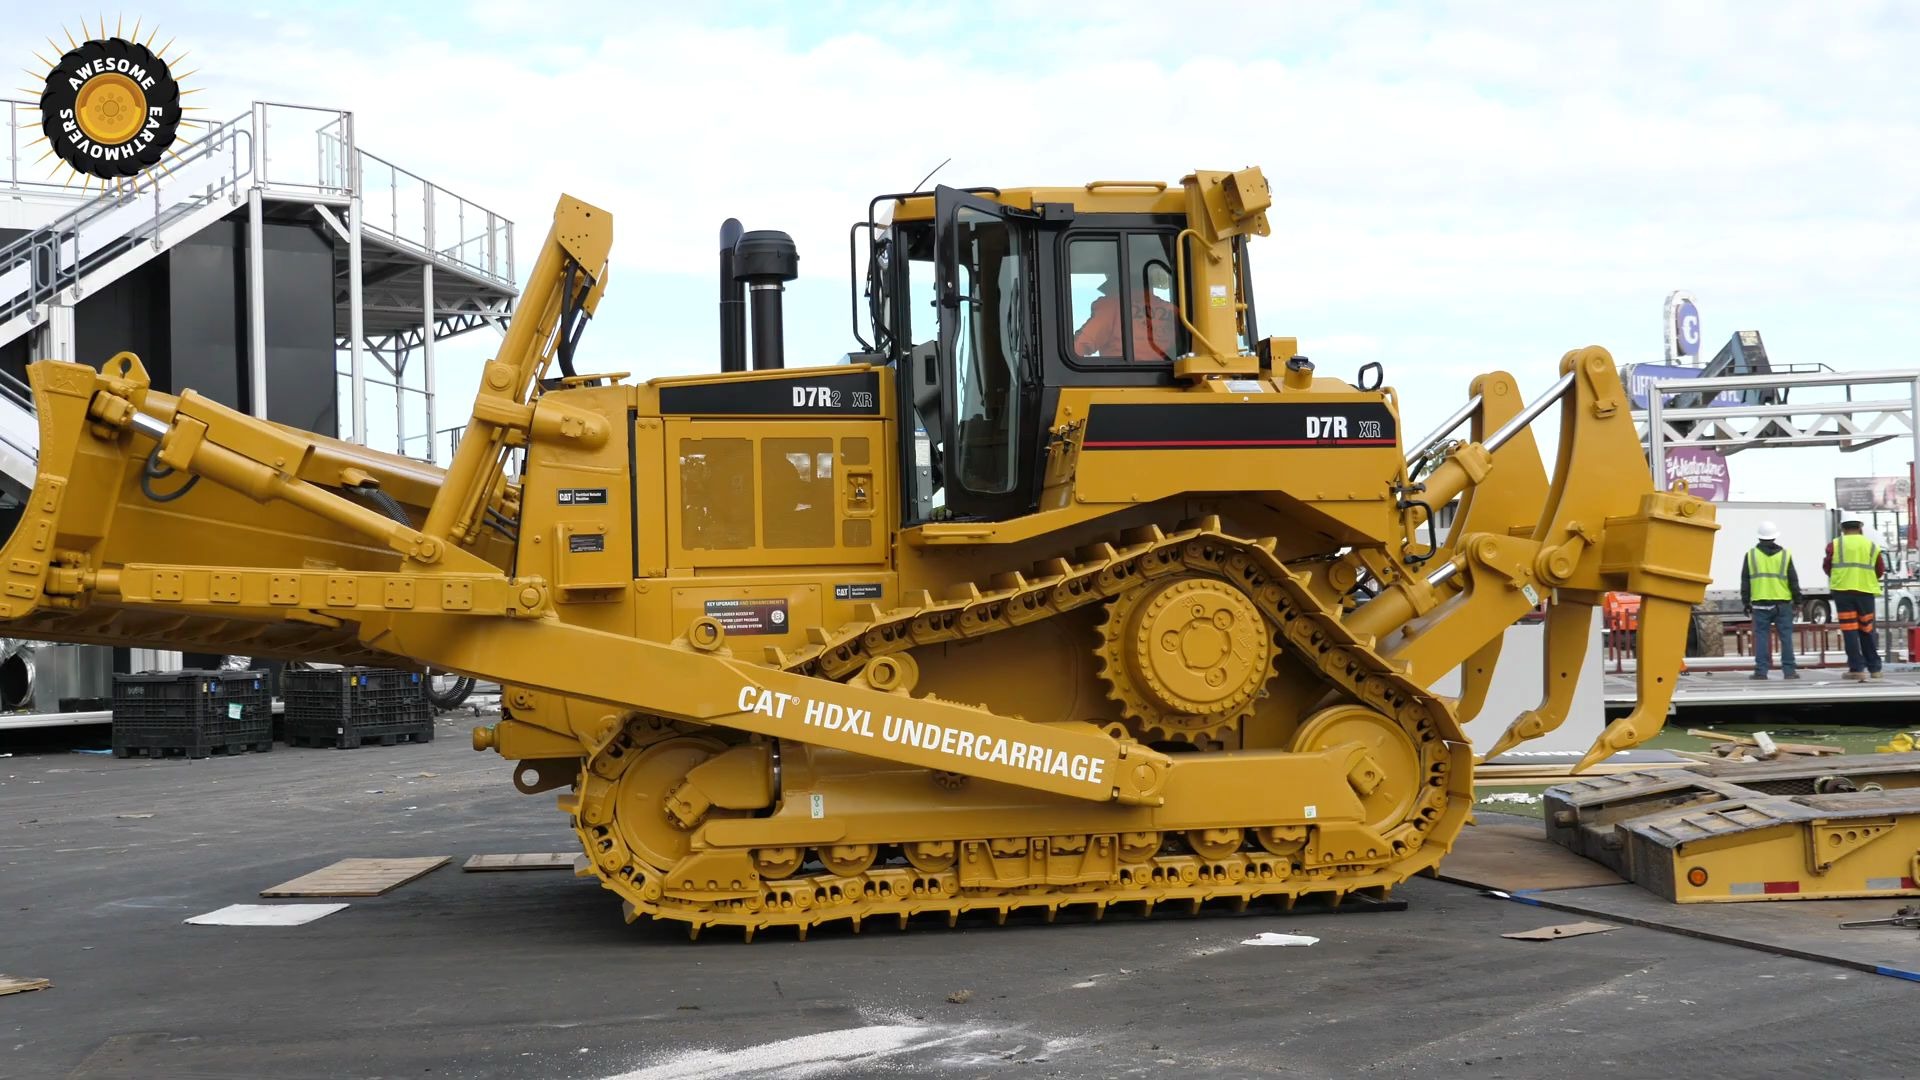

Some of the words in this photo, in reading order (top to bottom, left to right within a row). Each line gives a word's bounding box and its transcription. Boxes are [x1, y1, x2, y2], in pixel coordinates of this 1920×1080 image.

[1681, 315, 1699, 345] C
[852, 391, 873, 408] XR
[1306, 416, 1348, 438] D7R
[1358, 421, 1381, 438] XR
[559, 493, 571, 501] CAT
[836, 588, 848, 596] CAT
[804, 699, 874, 738] HDXL
[882, 715, 1105, 784] UNDERCARRIAGE
